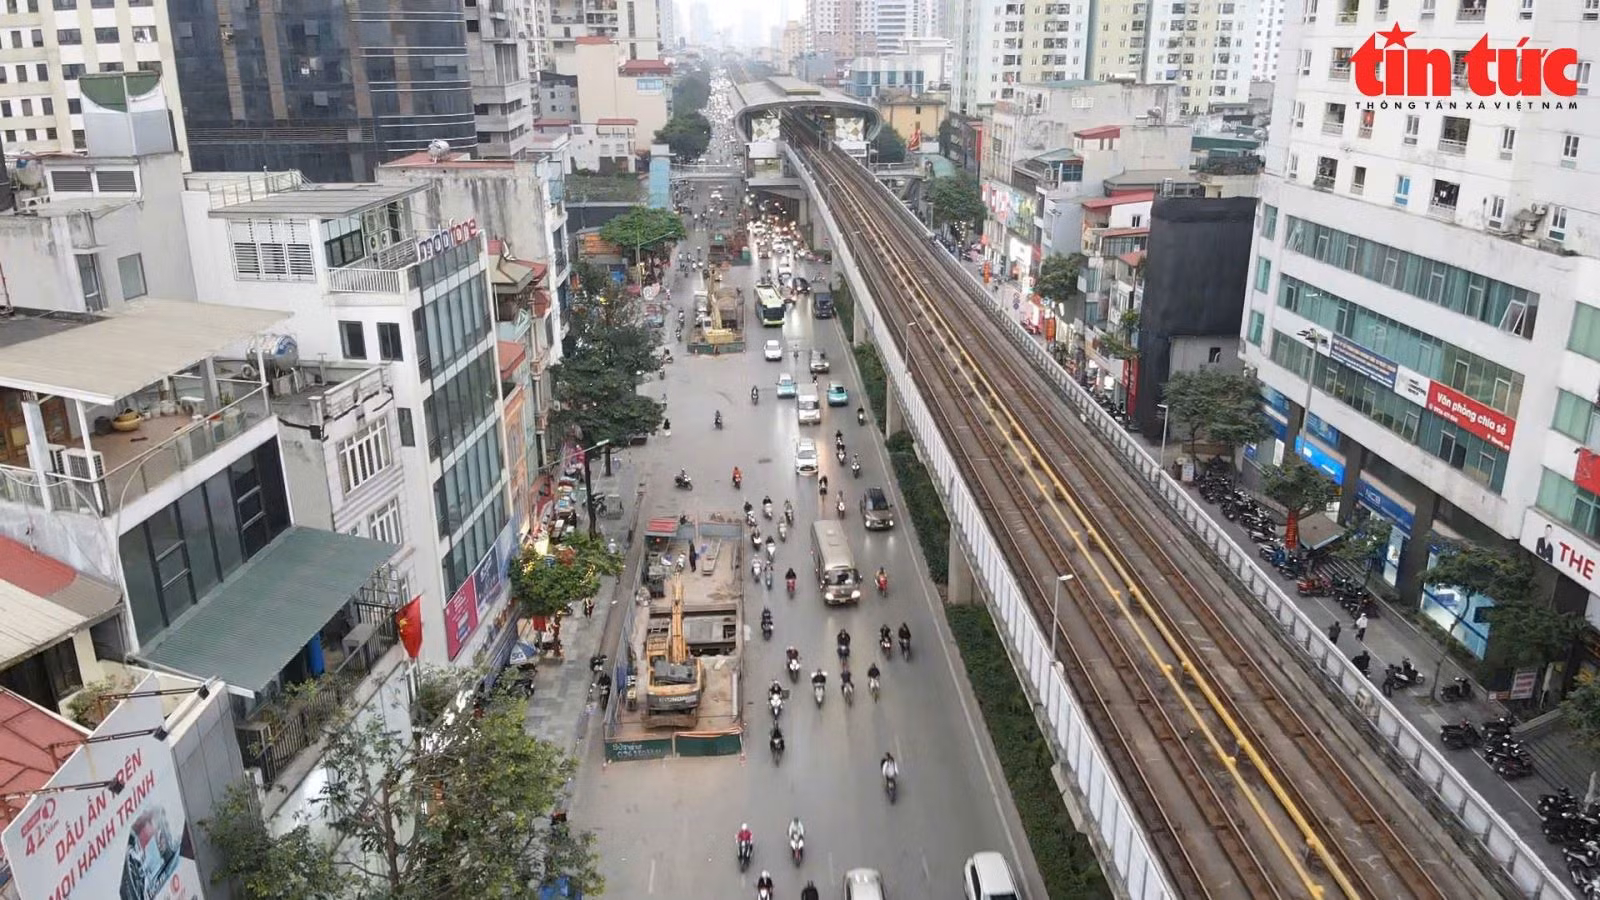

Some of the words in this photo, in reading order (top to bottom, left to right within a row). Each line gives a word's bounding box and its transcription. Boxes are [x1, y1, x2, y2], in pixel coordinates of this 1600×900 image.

[417, 217, 477, 262] mobifone
[1437, 392, 1452, 407] Văn
[1477, 413, 1496, 430] chia
[1558, 541, 1596, 581] THE
[77, 818, 116, 879] HÀNH
[116, 770, 155, 826] TRÌNH
